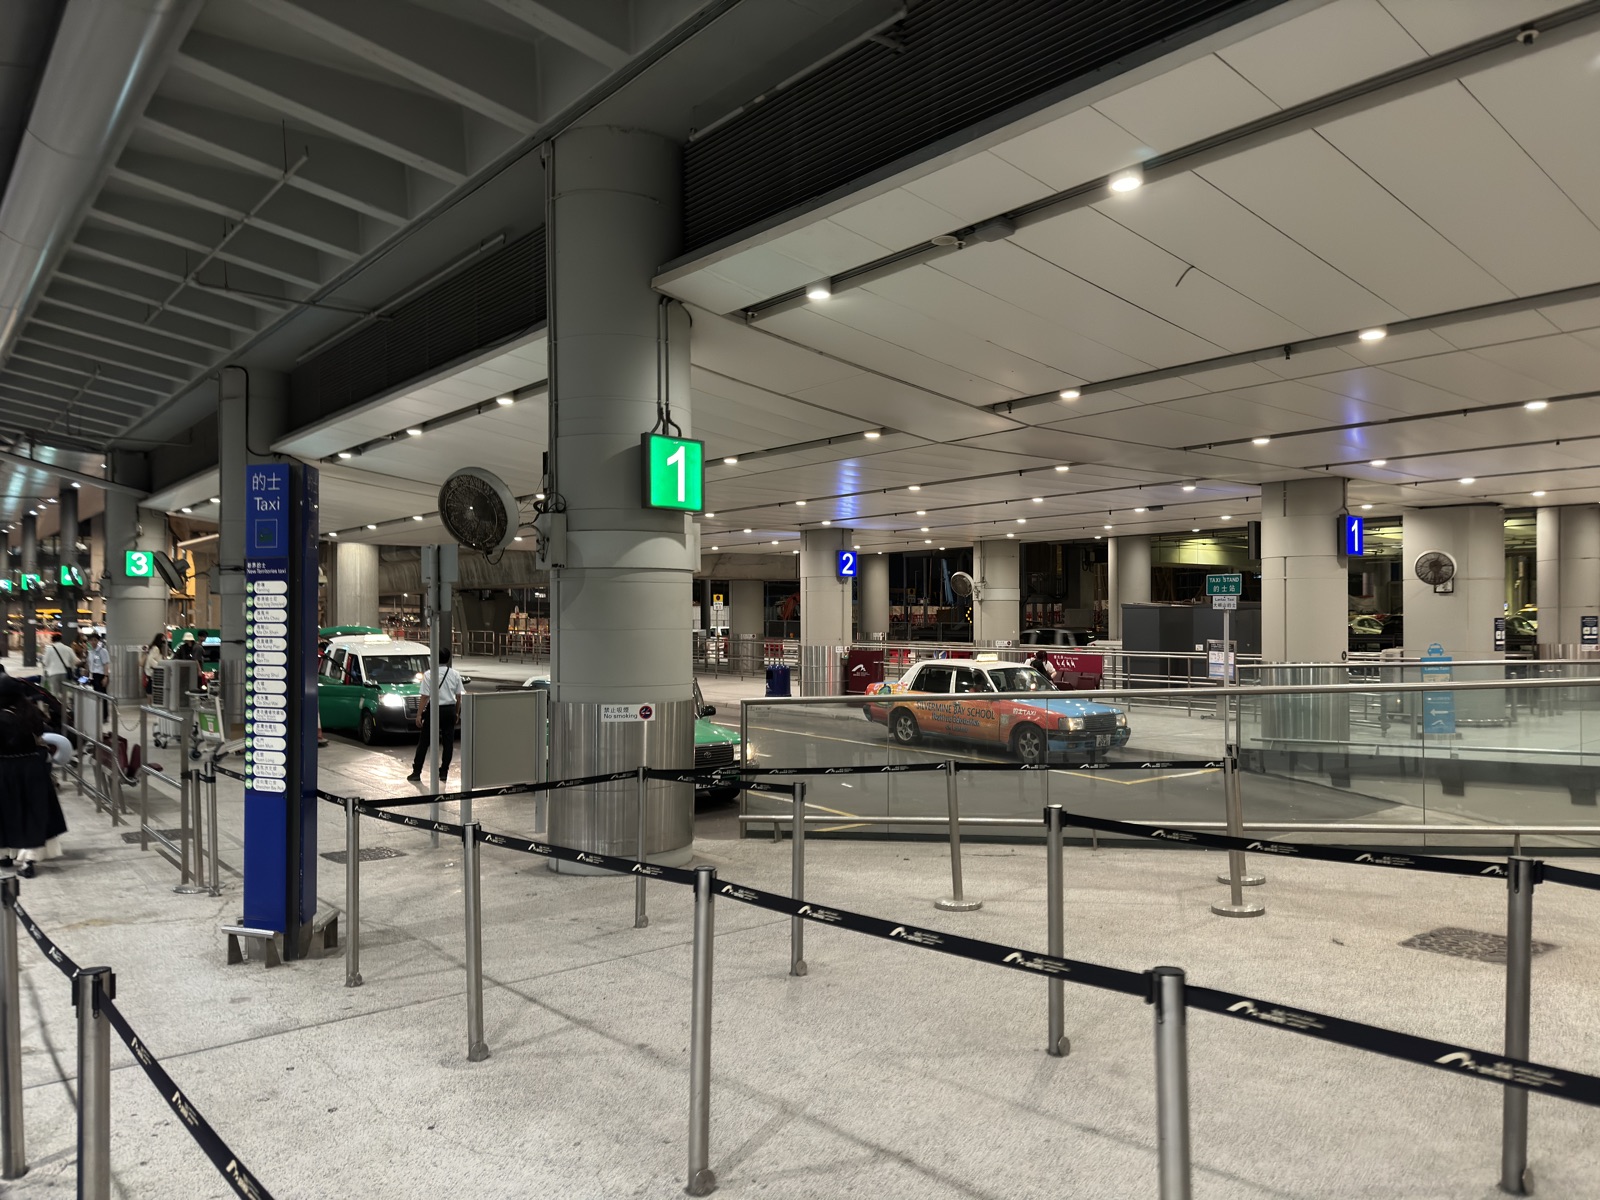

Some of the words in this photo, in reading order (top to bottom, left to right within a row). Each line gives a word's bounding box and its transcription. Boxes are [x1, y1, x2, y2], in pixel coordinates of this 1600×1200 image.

[252, 472, 282, 492] 的士
[667, 446, 686, 502] 1
[254, 496, 280, 512] Taxi
[1352, 520, 1358, 552] 1
[130, 553, 149, 575] 3
[842, 553, 854, 575] 2
[916, 701, 951, 714] SILVERMINE
[953, 706, 966, 715] BAY
[967, 708, 995, 719] SCHOOL
[952, 715, 980, 726] Education
